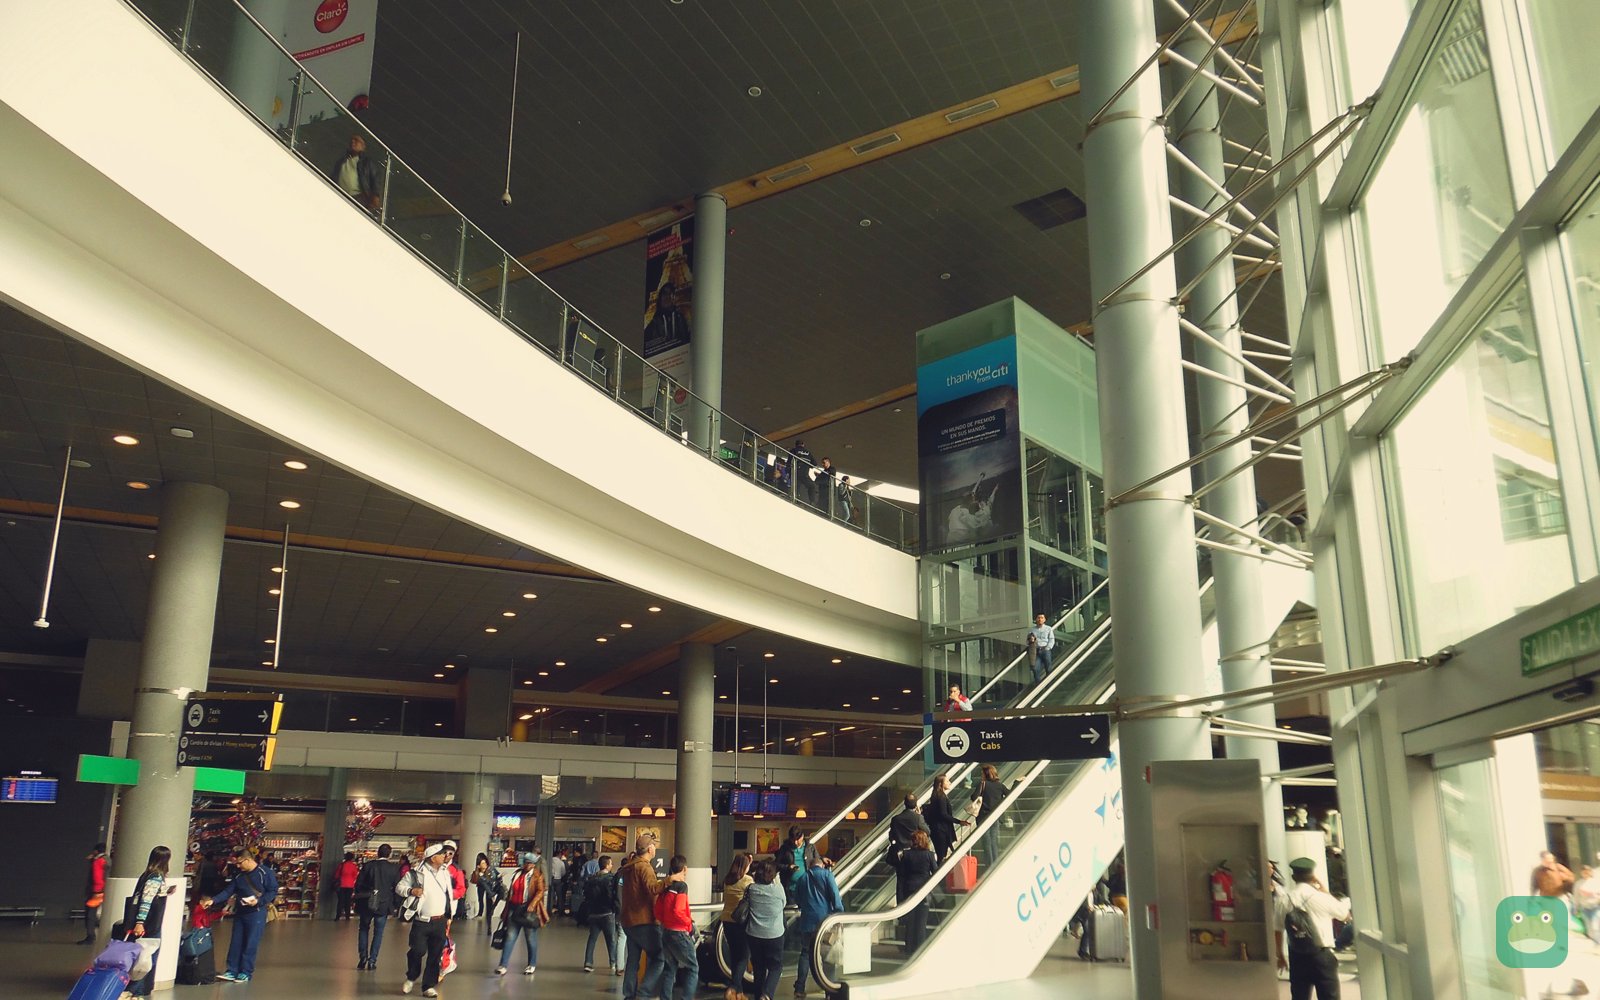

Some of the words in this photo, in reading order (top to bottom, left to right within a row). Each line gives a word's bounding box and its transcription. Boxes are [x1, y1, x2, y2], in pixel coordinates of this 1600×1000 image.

[316, 8, 342, 21] Claro
[946, 365, 991, 386] thankyou
[976, 375, 991, 383] from
[991, 365, 1008, 379] citi
[949, 424, 966, 432] MUNDO
[974, 415, 996, 426] PREMIOS
[1577, 612, 1600, 652] EX
[980, 730, 1003, 740] Taxis
[980, 741, 1001, 750] Cabs
